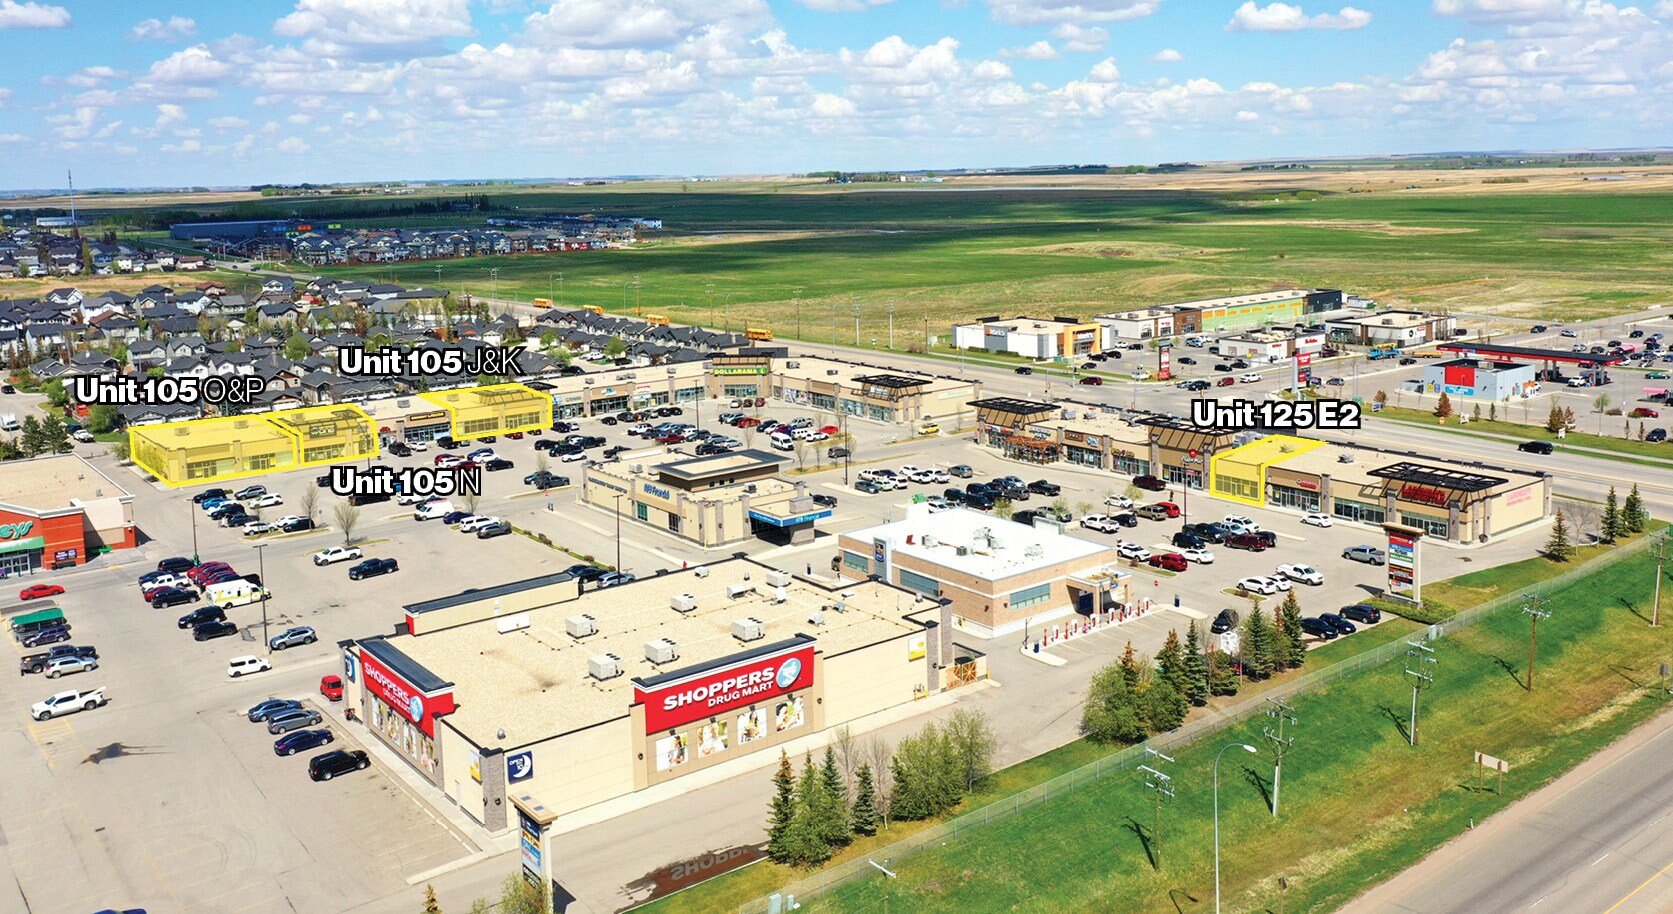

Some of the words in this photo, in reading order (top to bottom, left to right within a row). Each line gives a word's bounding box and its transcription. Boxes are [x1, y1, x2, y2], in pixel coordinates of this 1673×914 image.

[364, 662, 410, 705] SHOPPERS
[663, 667, 774, 711] SHOPPERS
[707, 691, 740, 708] DRUG
[742, 681, 774, 697] MART
